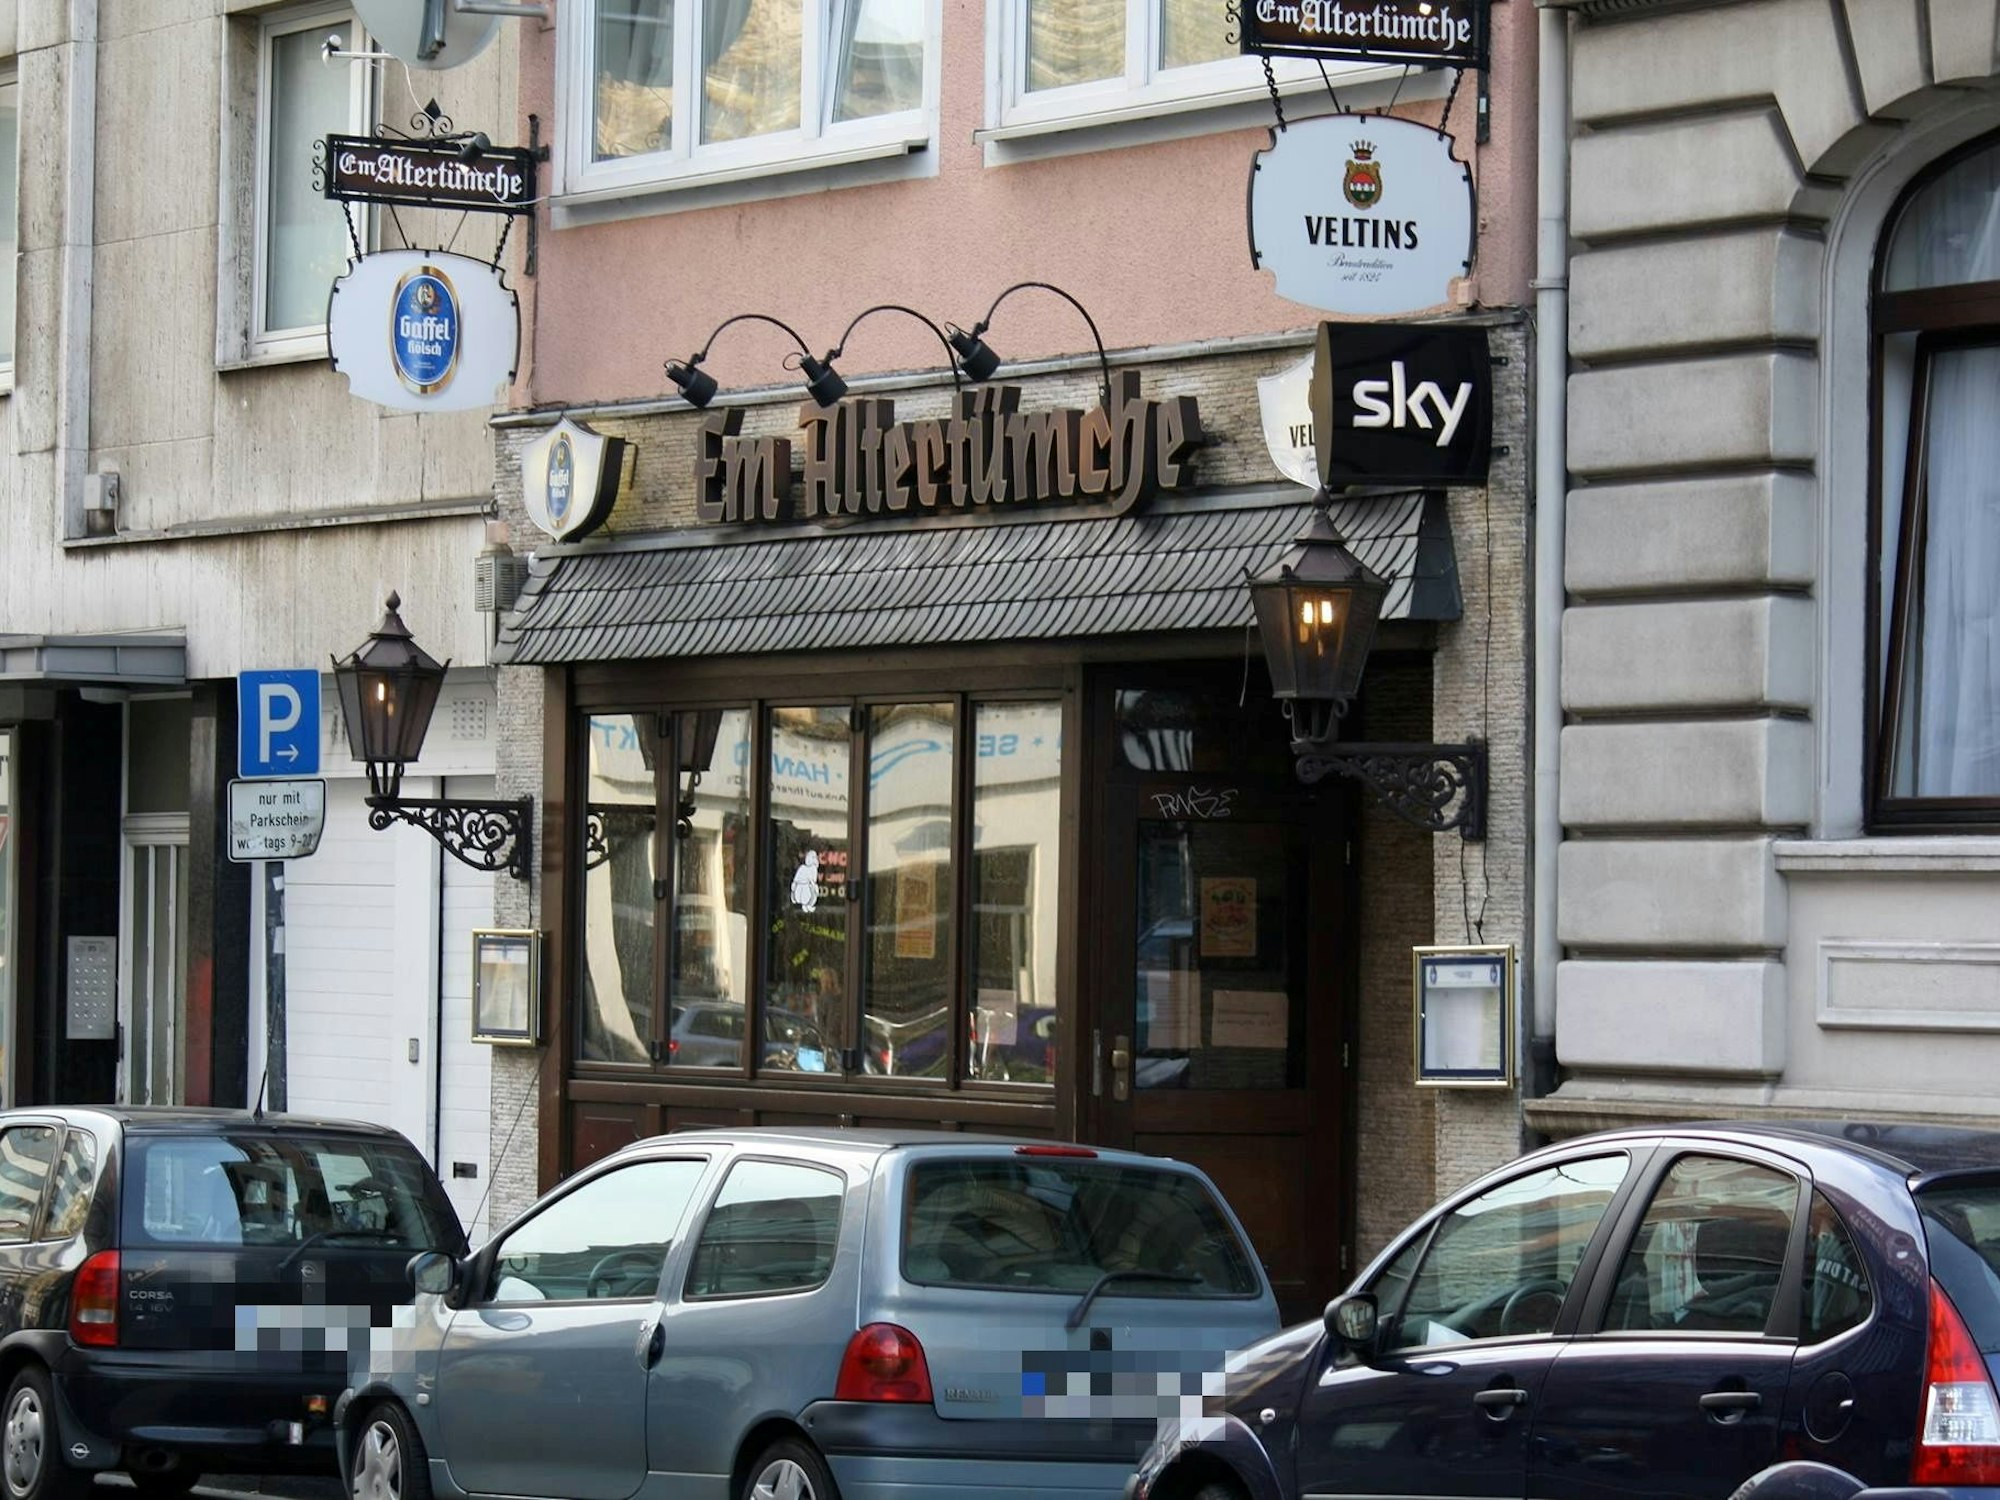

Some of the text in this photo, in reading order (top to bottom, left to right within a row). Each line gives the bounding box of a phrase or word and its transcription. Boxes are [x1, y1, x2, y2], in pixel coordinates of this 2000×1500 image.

[1256, 0, 1472, 51] Em Altertümche
[339, 152, 523, 200] Em Altertümche
[1304, 215, 1418, 250] VELTINS
[400, 315, 450, 341] Gaffel
[1352, 360, 1473, 447] sky
[695, 386, 1194, 522] Em Altertümche
[259, 683, 302, 763] P
[258, 790, 301, 806] nur mit
[250, 812, 310, 828] Parkschein
[129, 1290, 175, 1300] CORSA
